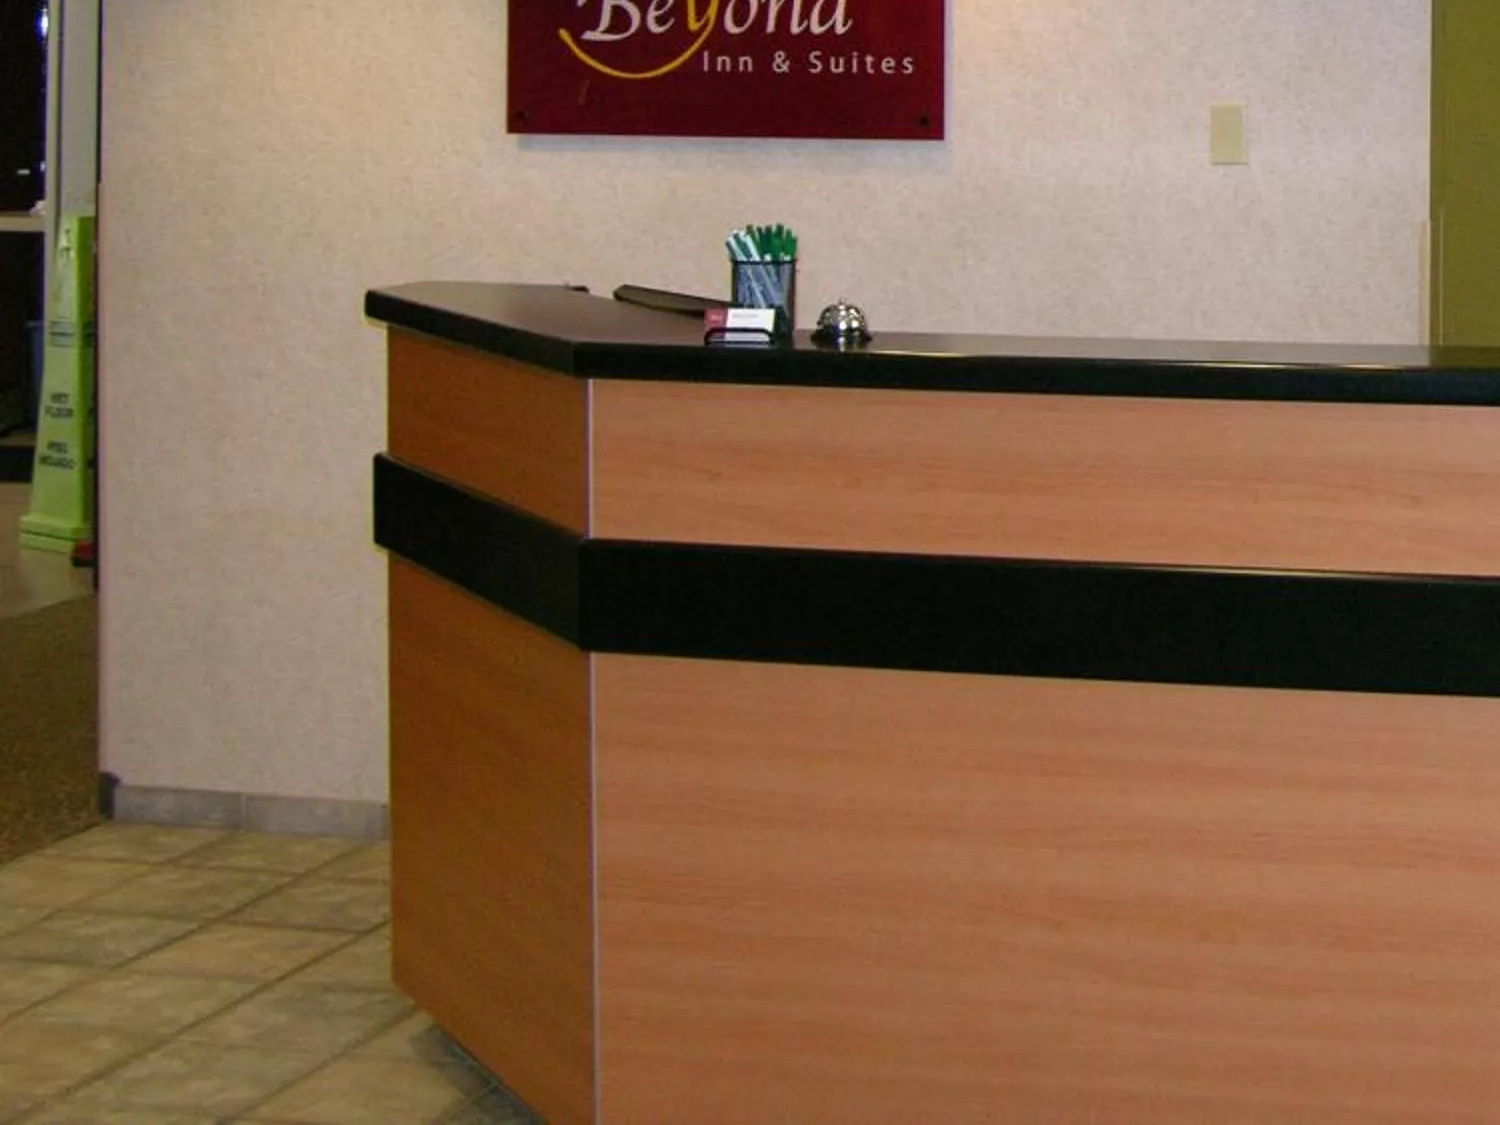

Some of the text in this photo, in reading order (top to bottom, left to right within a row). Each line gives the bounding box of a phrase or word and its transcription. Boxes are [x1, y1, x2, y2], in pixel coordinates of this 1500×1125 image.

[702, 50, 915, 75] Inn & Suites
